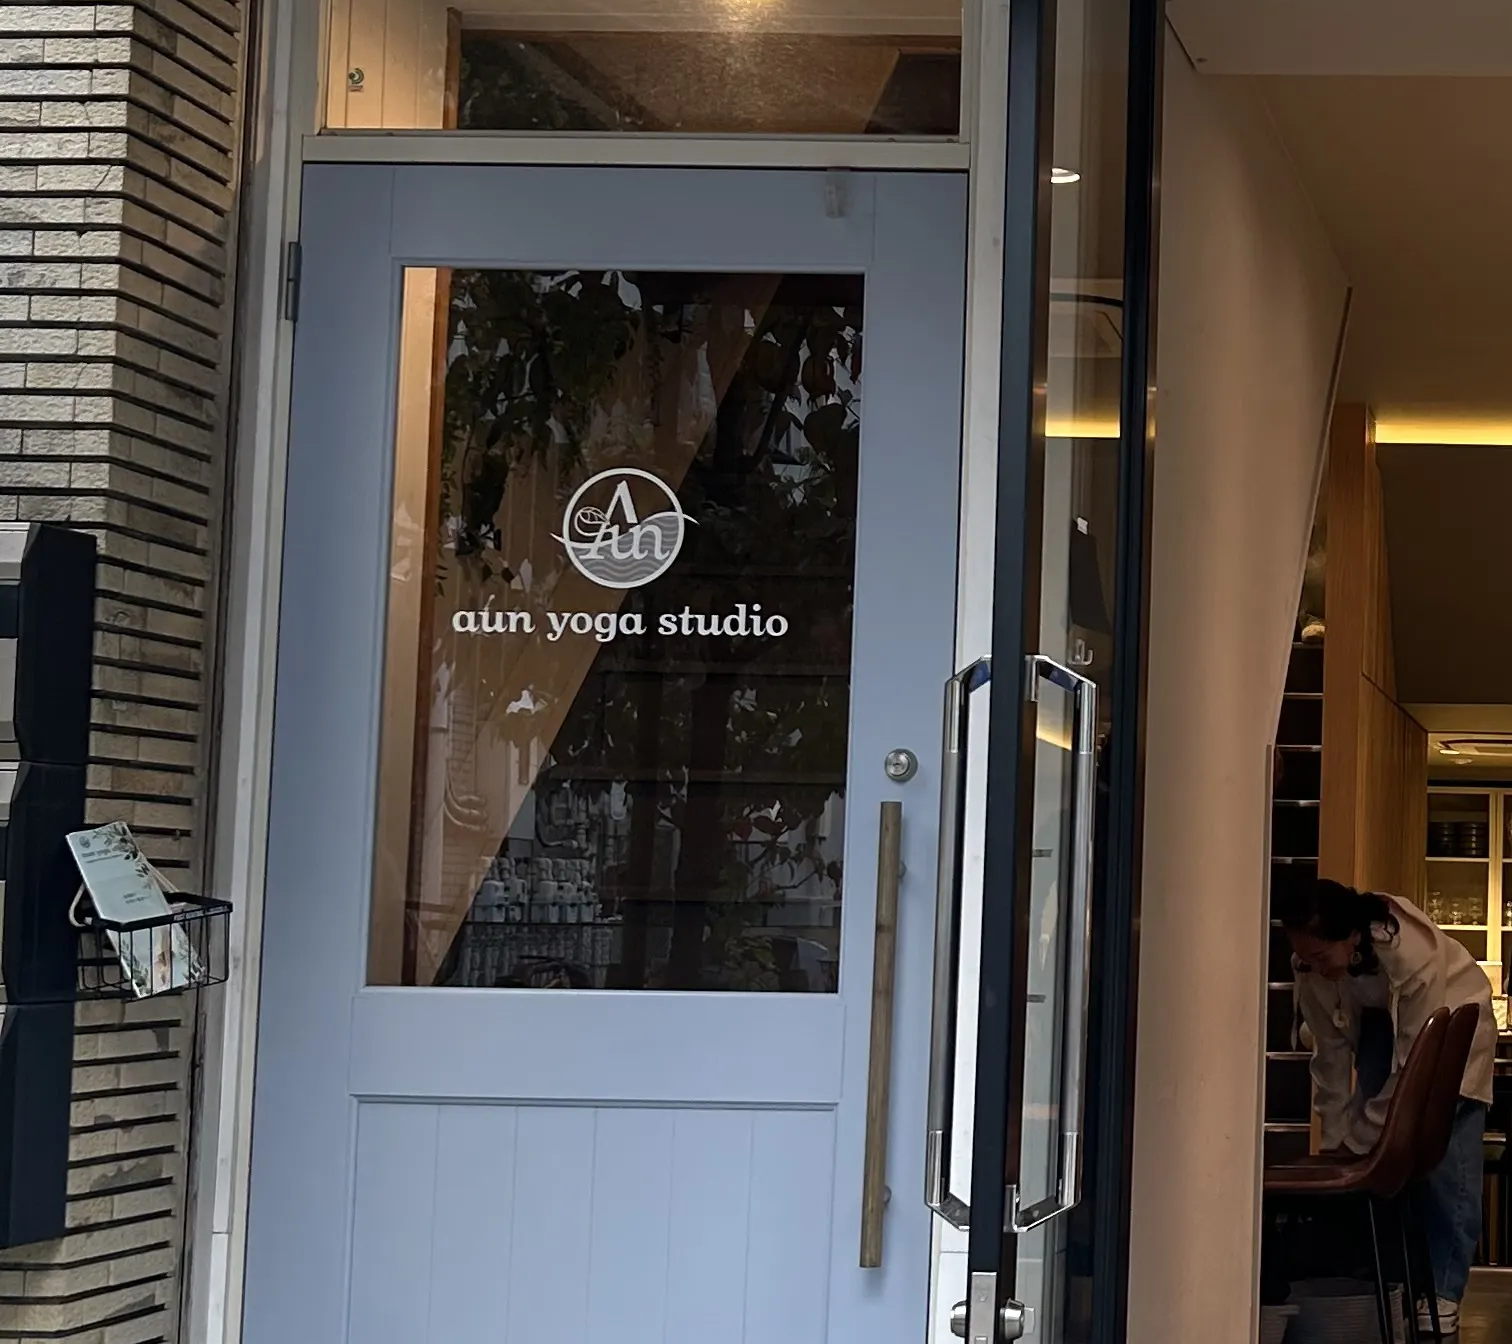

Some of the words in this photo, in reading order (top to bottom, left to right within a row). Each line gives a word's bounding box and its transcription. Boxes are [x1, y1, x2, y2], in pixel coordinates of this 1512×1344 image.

[452, 608, 536, 634] aun
[547, 609, 647, 643] yoga
[658, 603, 789, 637] studio
